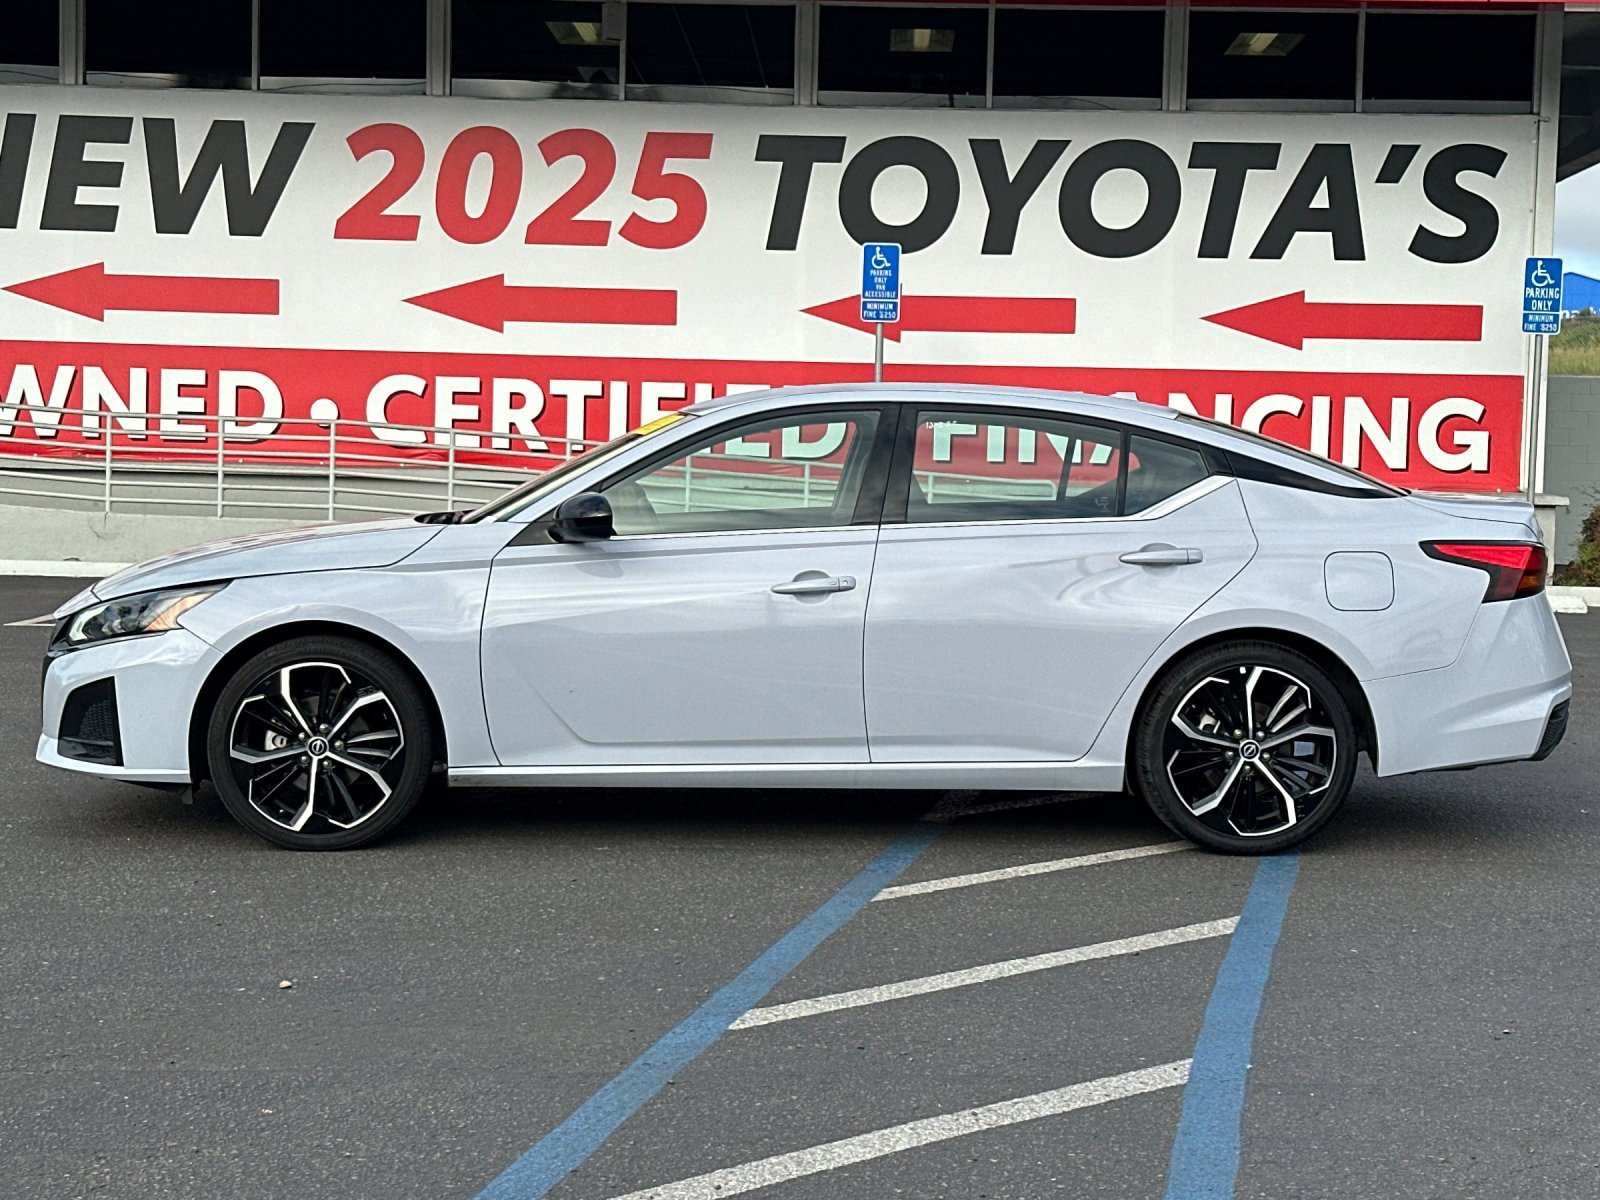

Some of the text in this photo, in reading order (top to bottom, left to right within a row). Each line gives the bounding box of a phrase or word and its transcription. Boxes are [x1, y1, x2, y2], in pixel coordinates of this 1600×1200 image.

[333, 122, 714, 249] 2025
[755, 134, 1509, 264] TOYOTA'S
[870, 269, 892, 277] PARKING
[1525, 287, 1560, 299] PARKING
[866, 302, 893, 310] MINIMUM
[1531, 300, 1553, 311] ONLY
[863, 310, 896, 319] FINE $250
[1528, 314, 1554, 322] MINIMUM
[1524, 323, 1557, 332] FINE $250
[932, 388, 1491, 473] FINCING
